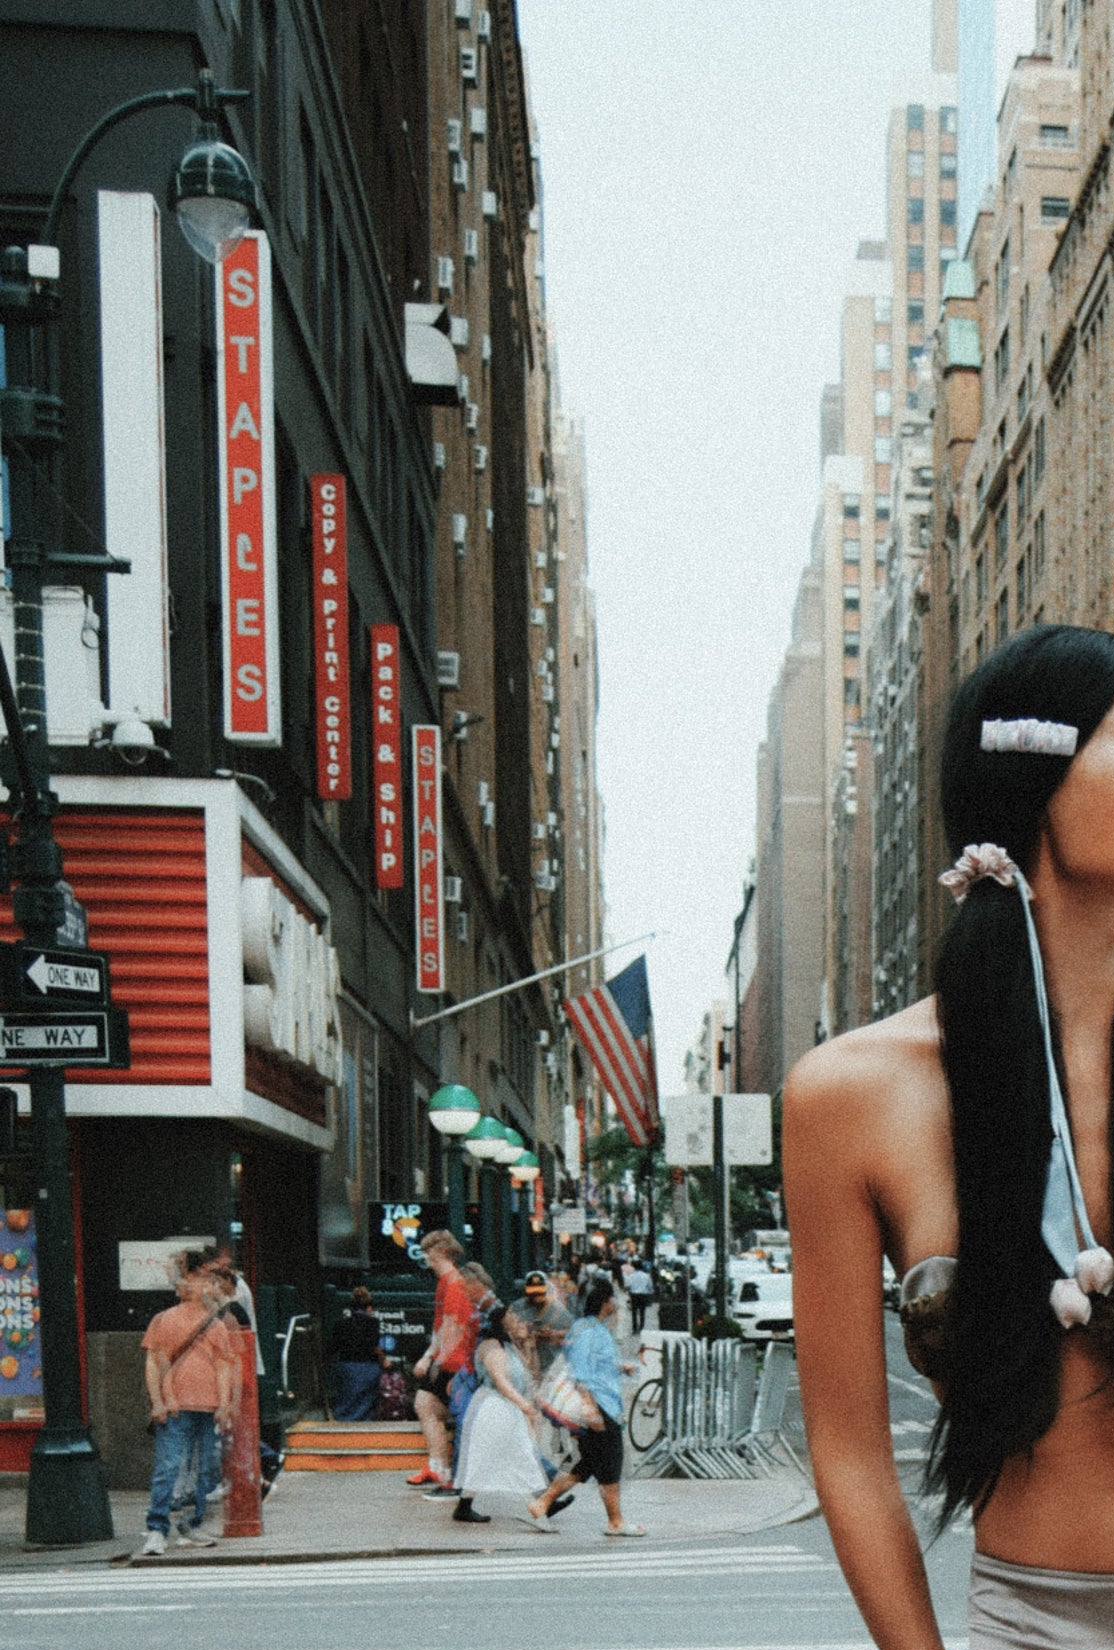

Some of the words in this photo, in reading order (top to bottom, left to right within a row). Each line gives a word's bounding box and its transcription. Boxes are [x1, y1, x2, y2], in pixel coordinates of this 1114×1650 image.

[228, 268, 263, 701] STAPLES
[320, 483, 337, 554] Copy
[321, 567, 338, 585] &
[322, 599, 339, 682] Print
[376, 642, 394, 724] Pack
[324, 695, 341, 791] Center
[377, 743, 395, 763] &
[379, 782, 397, 872] Ship
[419, 745, 438, 973] STAPLES
[48, 966, 71, 986] ONE
[75, 968, 96, 988] WAY
[0, 1028, 26, 1046] NE
[44, 1027, 87, 1046] WAY
[381, 1203, 422, 1219] TAP
[379, 1322, 425, 1335] Station
